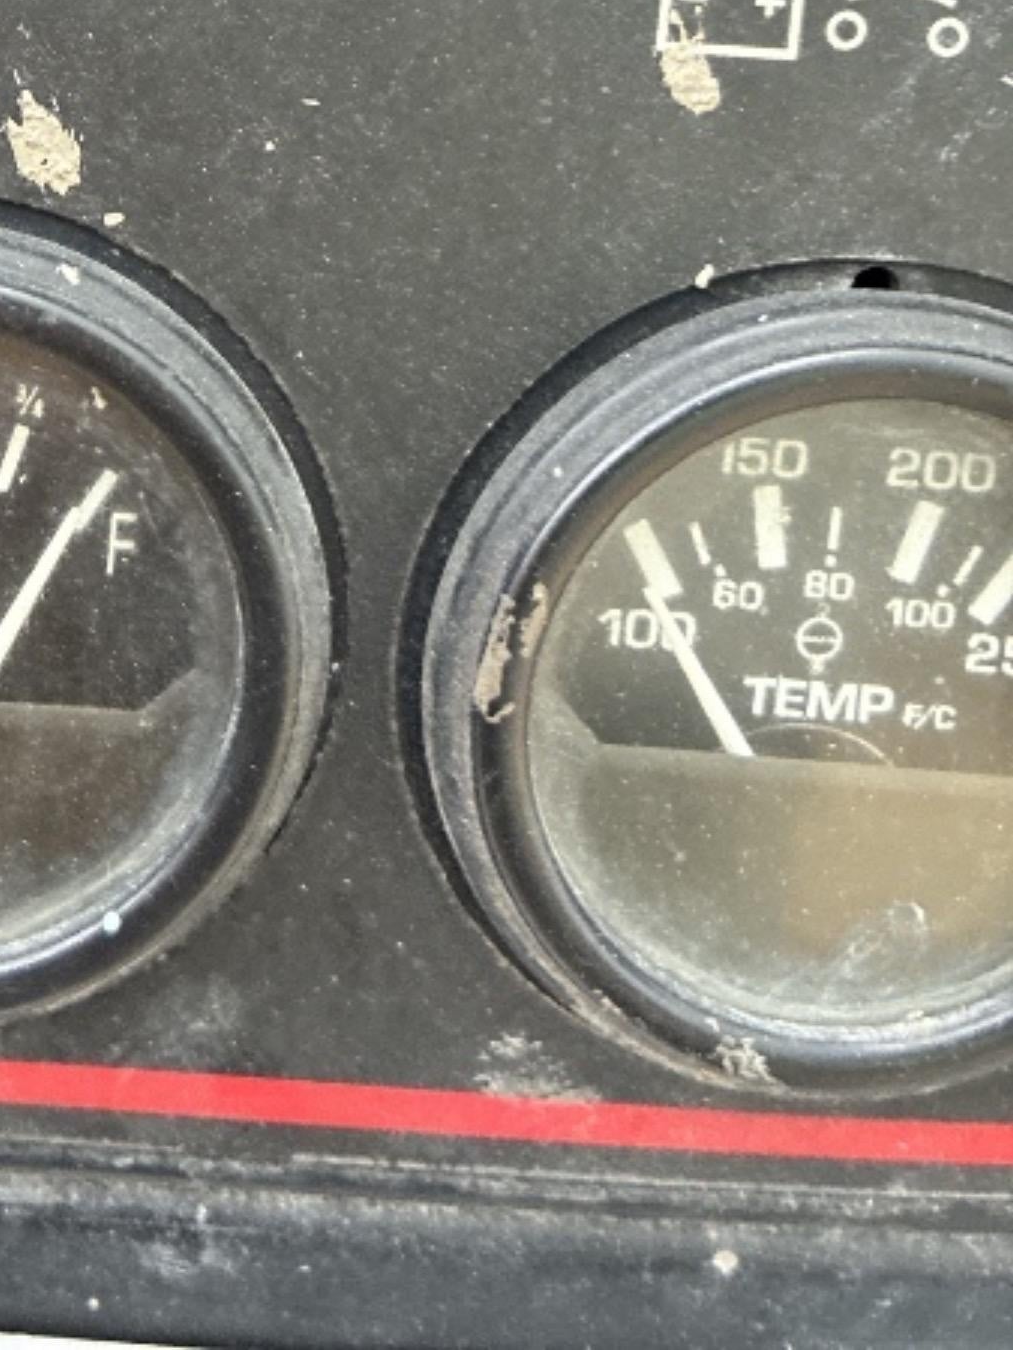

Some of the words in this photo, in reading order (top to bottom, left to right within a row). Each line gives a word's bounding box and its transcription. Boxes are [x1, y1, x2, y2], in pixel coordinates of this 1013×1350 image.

[720, 436, 809, 480] 150
[886, 447, 996, 493] 200
[106, 512, 138, 576] F
[713, 579, 765, 611] 60
[803, 570, 855, 601] 80
[597, 608, 698, 652] 100
[885, 598, 957, 629] 100
[743, 674, 895, 725] TEMP
[901, 702, 958, 731] F/C
